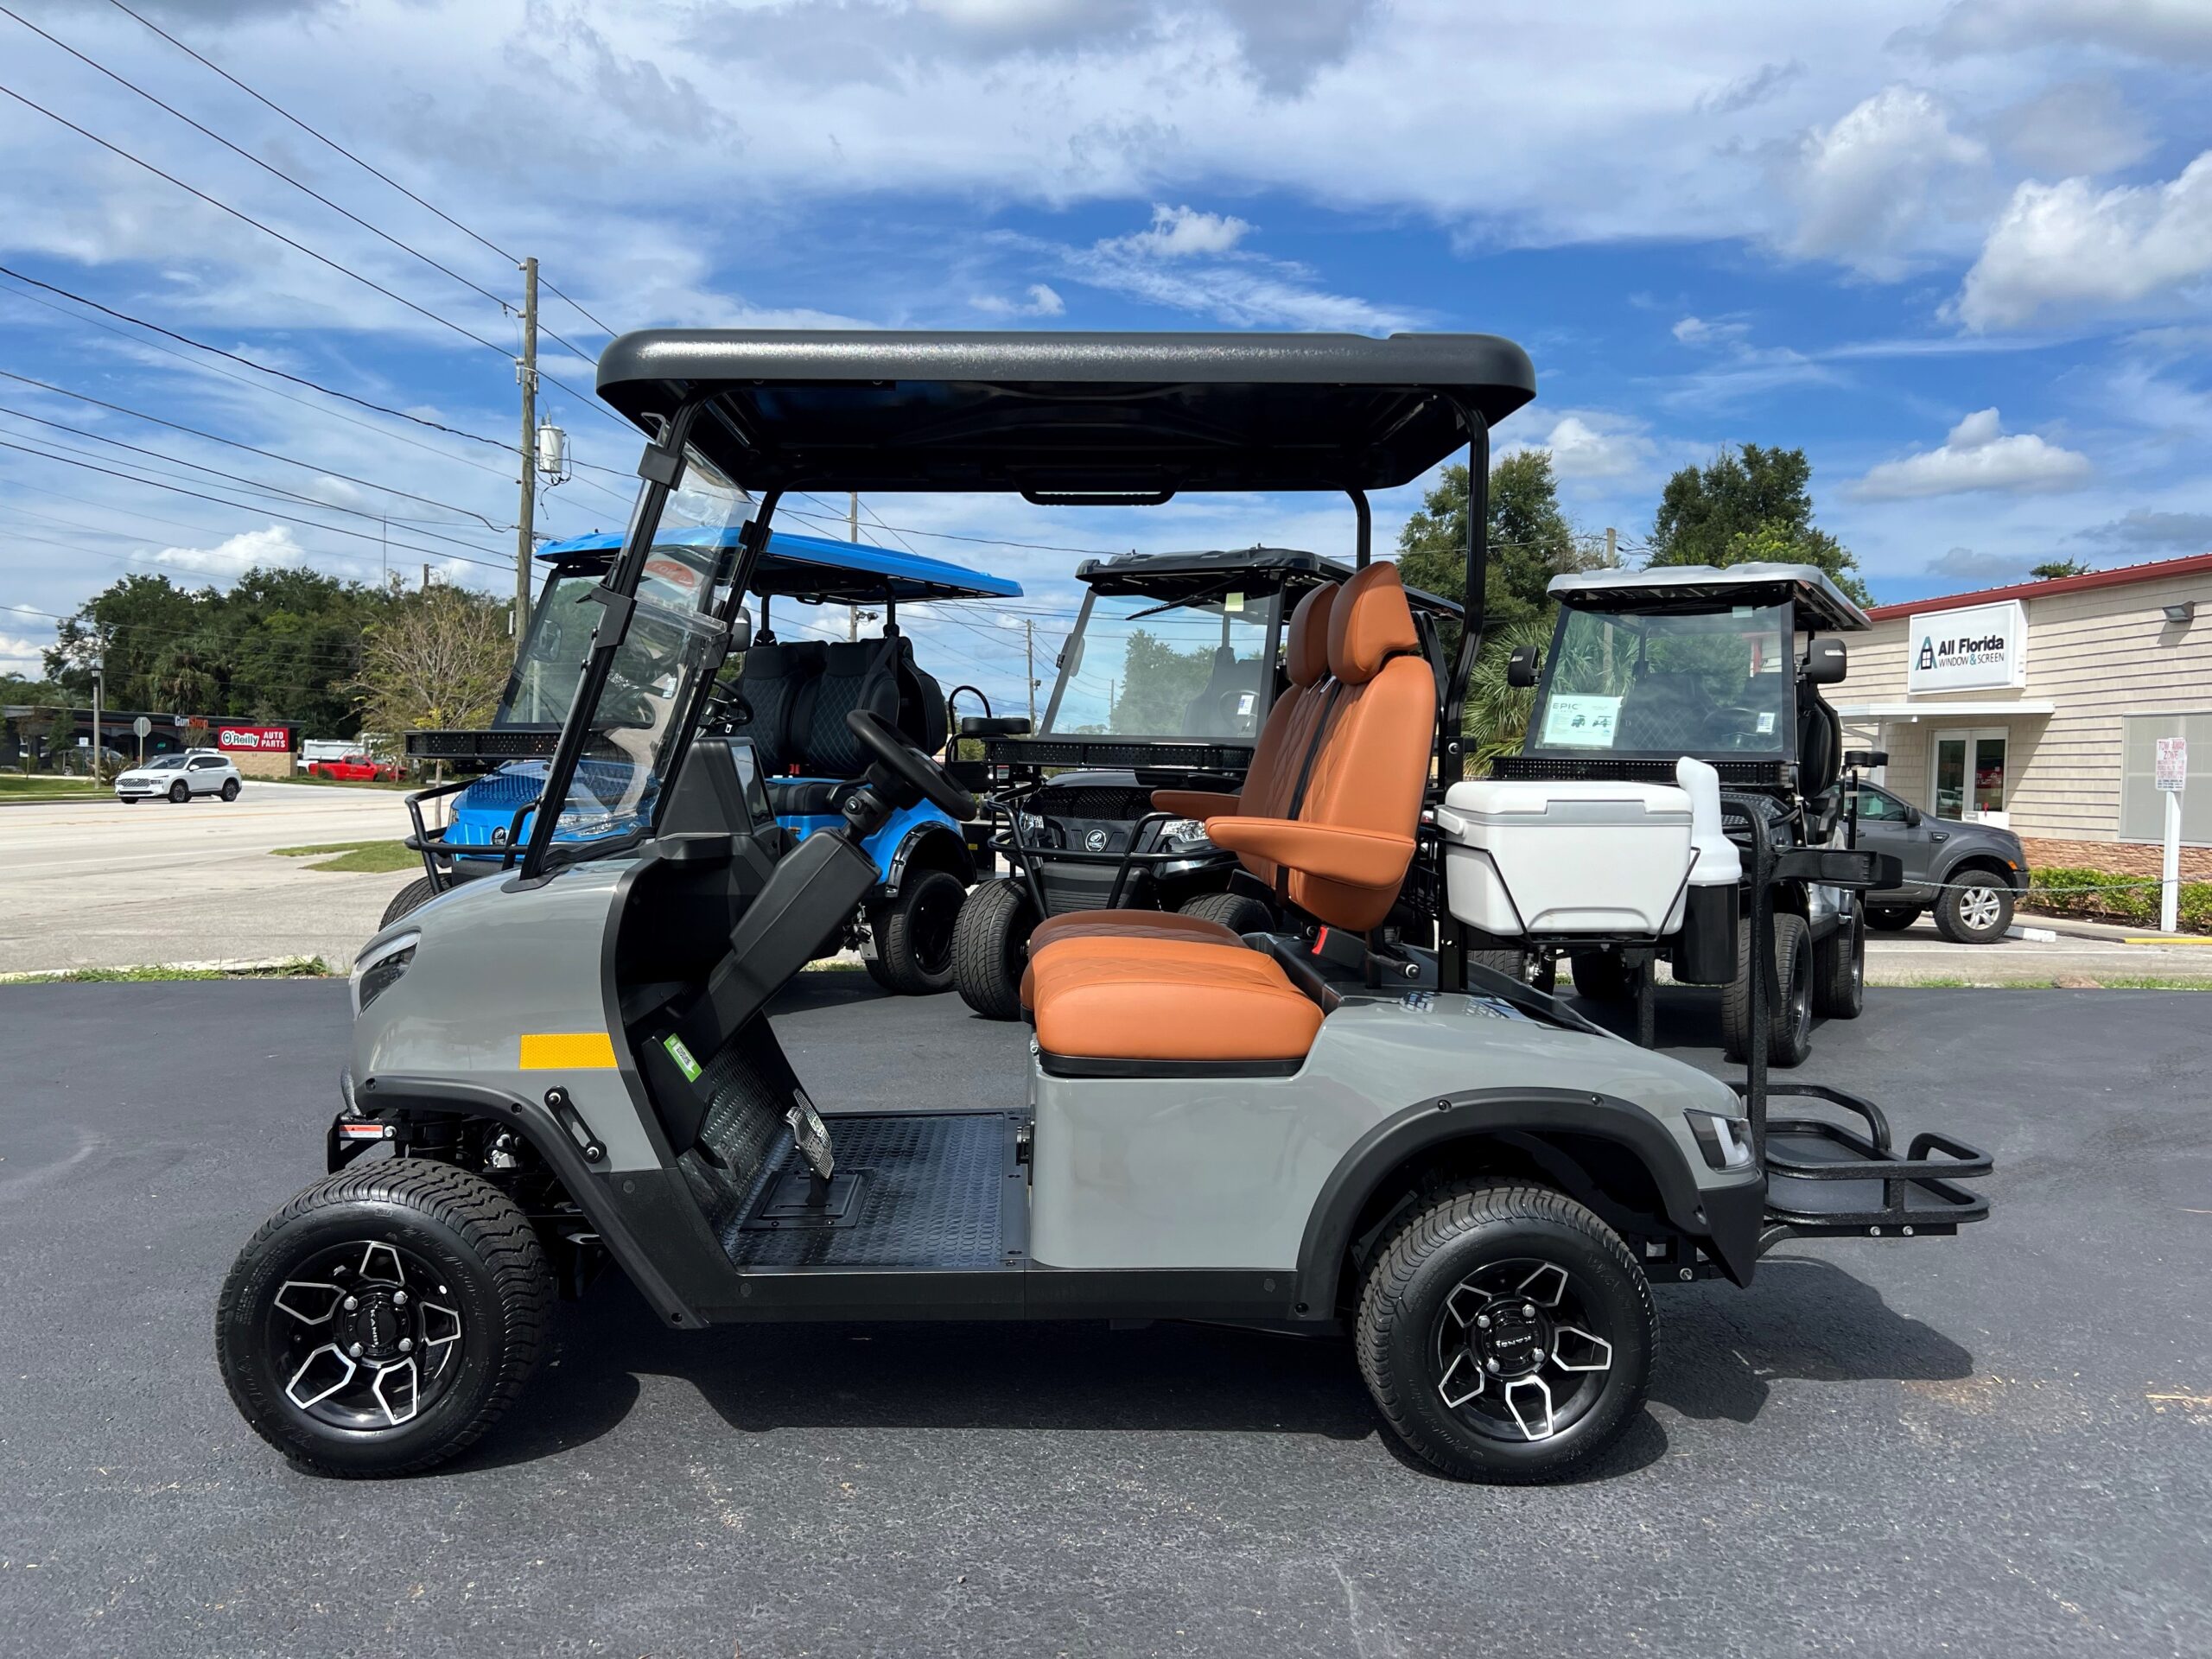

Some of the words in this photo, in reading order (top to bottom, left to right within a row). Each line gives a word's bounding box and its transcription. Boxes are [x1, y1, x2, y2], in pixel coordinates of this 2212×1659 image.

[1938, 640, 1955, 656] All
[1959, 635, 2004, 654] Florida
[1939, 657, 1968, 667] WINDOW
[1969, 654, 1976, 665] &
[1977, 652, 2005, 664] SCREEN
[221, 730, 259, 747] O'Reilly
[264, 731, 283, 740] AUTO
[261, 740, 285, 748] PARTS
